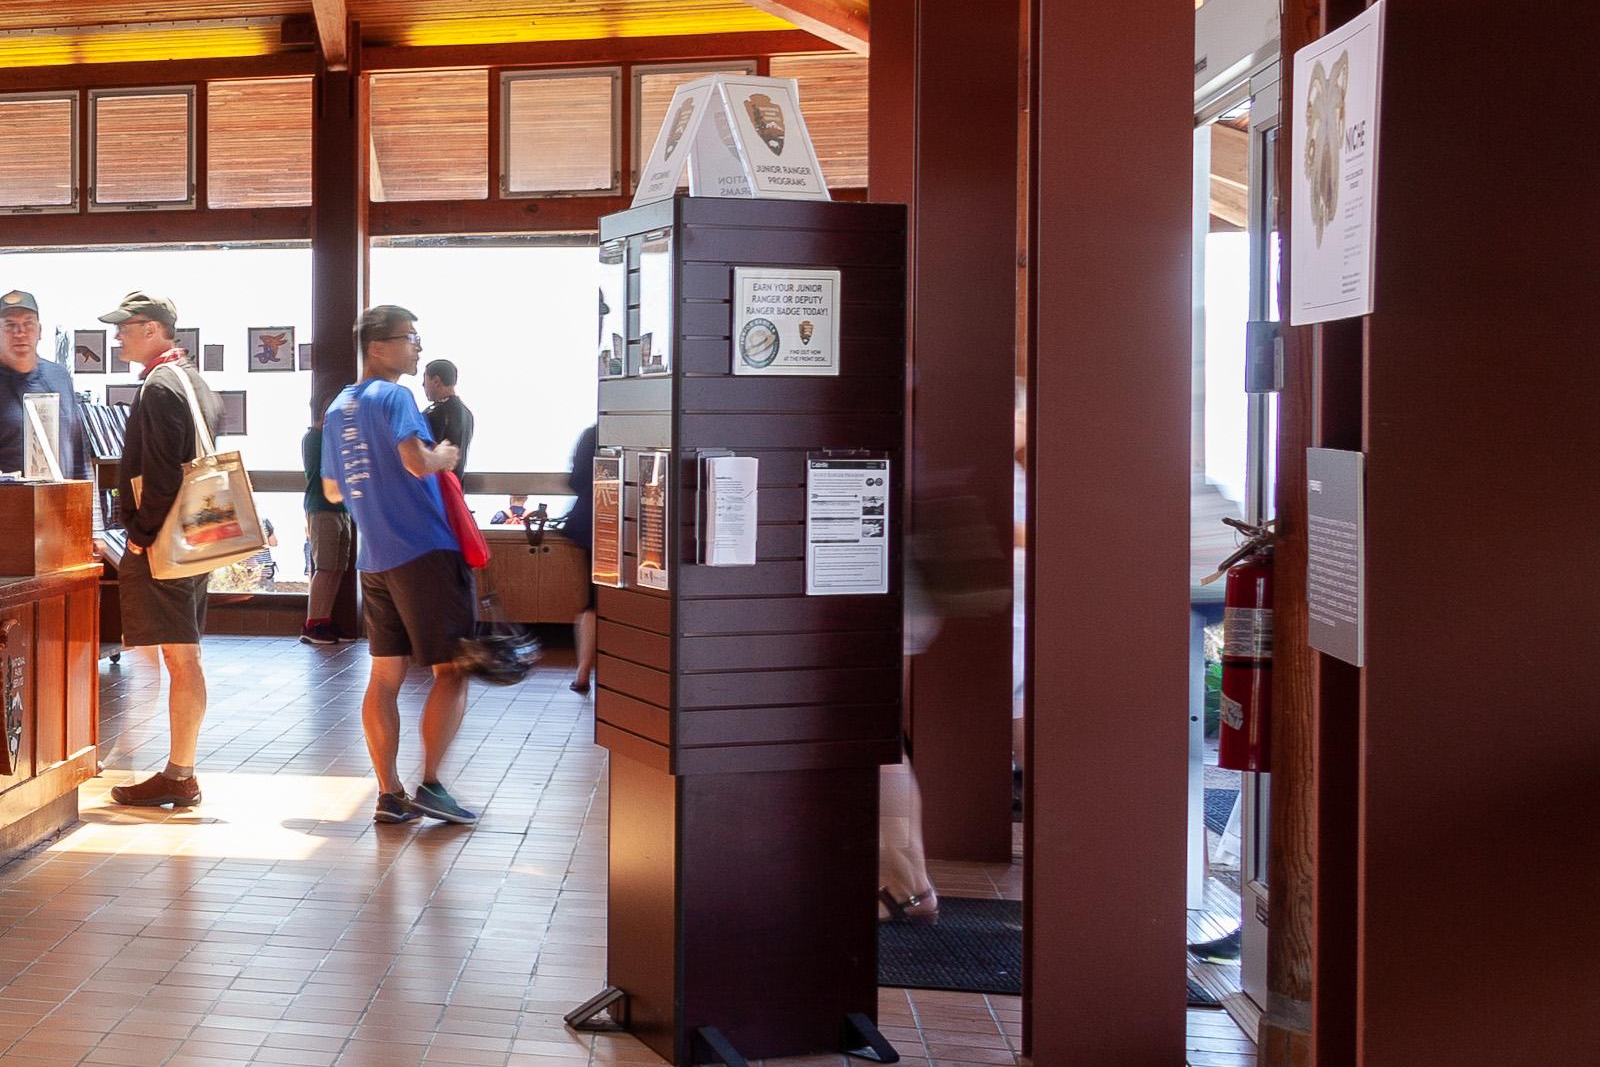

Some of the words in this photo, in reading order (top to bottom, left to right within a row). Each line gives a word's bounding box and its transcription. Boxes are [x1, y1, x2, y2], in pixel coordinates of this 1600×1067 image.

[756, 165, 782, 174] JUNIOR
[782, 166, 811, 175] RANGER
[767, 176, 806, 186] PROGRAMS
[753, 283, 772, 291] EARN
[774, 284, 794, 292] YOUR
[796, 284, 822, 292] JUNIOR
[752, 295, 780, 303] RANGER
[795, 296, 823, 304] DEPUTY
[777, 307, 800, 315] BADGE
